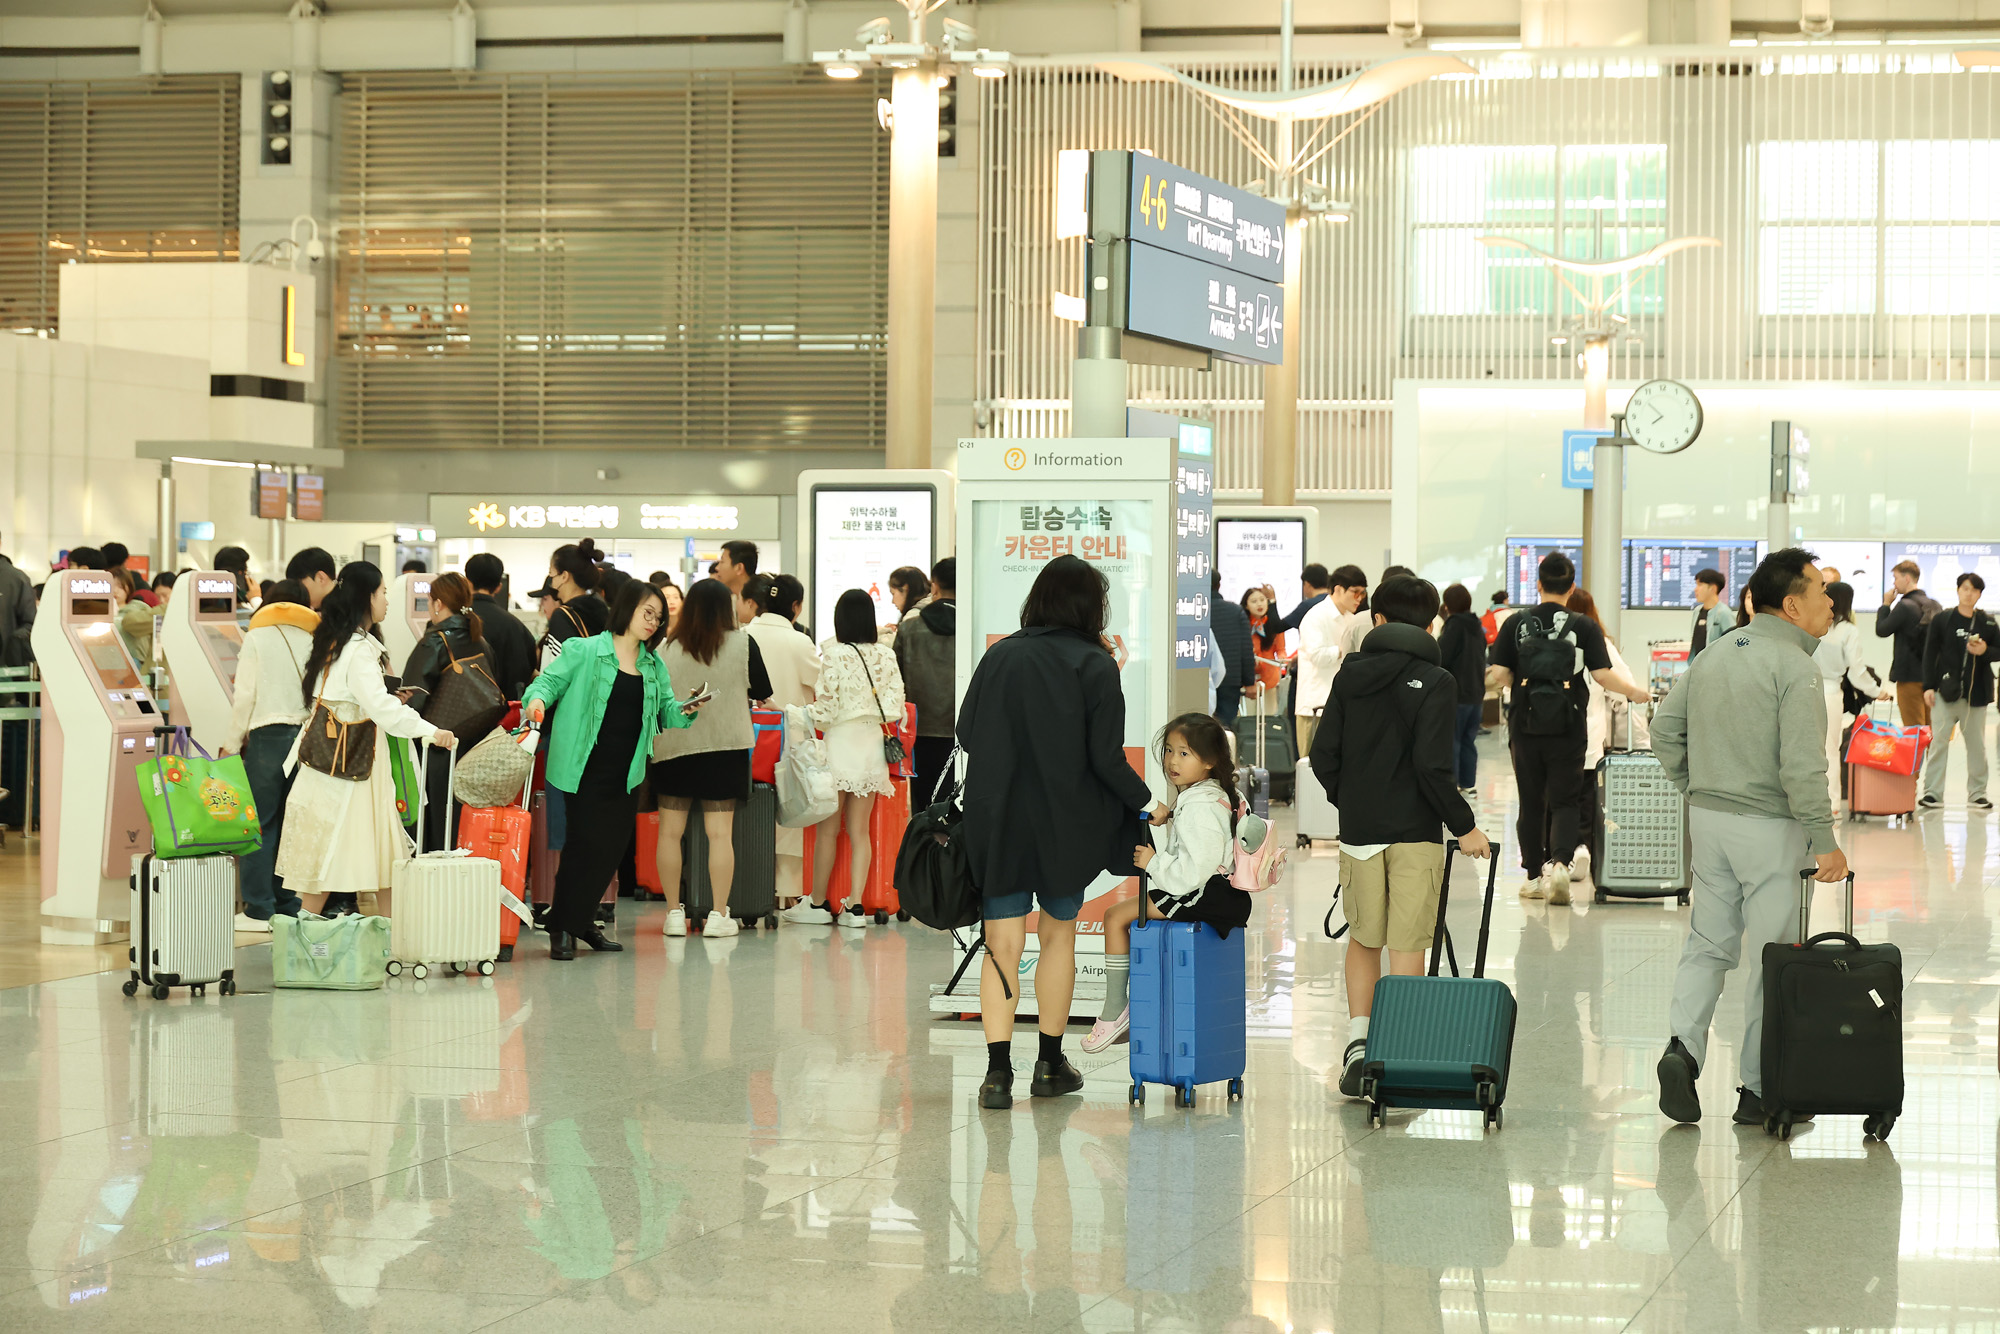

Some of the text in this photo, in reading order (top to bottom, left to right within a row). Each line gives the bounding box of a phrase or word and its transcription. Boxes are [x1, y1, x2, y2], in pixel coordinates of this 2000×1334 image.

[1140, 174, 1168, 231] 4-6
[1202, 225, 1233, 262] Boarding
[284, 284, 305, 366] L
[1209, 313, 1236, 341] Arrivals
[1238, 301, 1254, 334] 도착
[1034, 453, 1123, 466] Information
[850, 506, 898, 518] 위탁수하물
[1020, 506, 1112, 531] 탑승수속
[842, 520, 906, 531] 제한 물품 안내
[1005, 536, 1127, 560] 카운터 안내
[1905, 544, 1992, 554] SPARE BATTERIES
